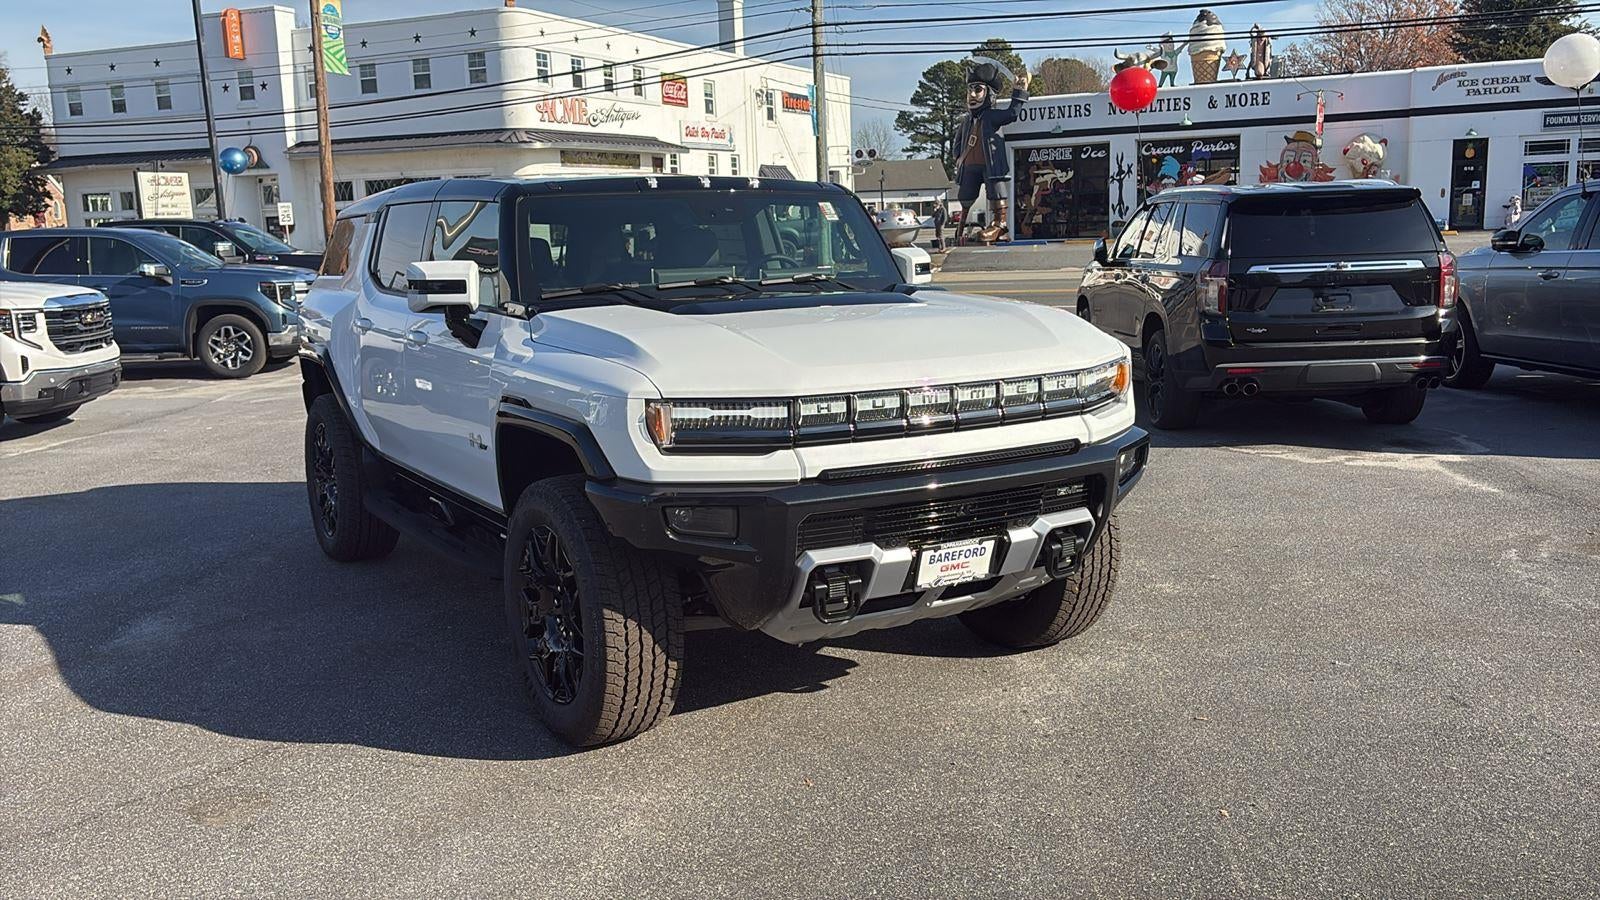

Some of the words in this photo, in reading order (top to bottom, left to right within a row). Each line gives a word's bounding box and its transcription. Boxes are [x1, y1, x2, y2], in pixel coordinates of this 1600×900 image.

[1456, 79, 1479, 88] ICE
[1481, 75, 1531, 86] CREAM
[1465, 85, 1520, 97] PARLOR
[783, 93, 811, 112] Fireston
[1019, 103, 1092, 122] OUVENIRS
[1108, 96, 1191, 116] NLTIES
[1207, 95, 1219, 109] &
[1225, 91, 1271, 109] MORE
[535, 97, 589, 125] ACME
[588, 102, 642, 128] Antiques
[1545, 115, 1579, 125] FOUNTAIN
[700, 126, 710, 140] Boy
[711, 127, 726, 140] Paints
[1028, 147, 1073, 162] ACME
[1080, 146, 1107, 159] Ice
[1141, 143, 1186, 156] Cream
[1191, 140, 1237, 154] Parlor
[281, 213, 292, 222] 25
[817, 380, 1067, 414] HUMMER
[928, 546, 987, 565] BAREFORD
[940, 561, 971, 573] GMC
